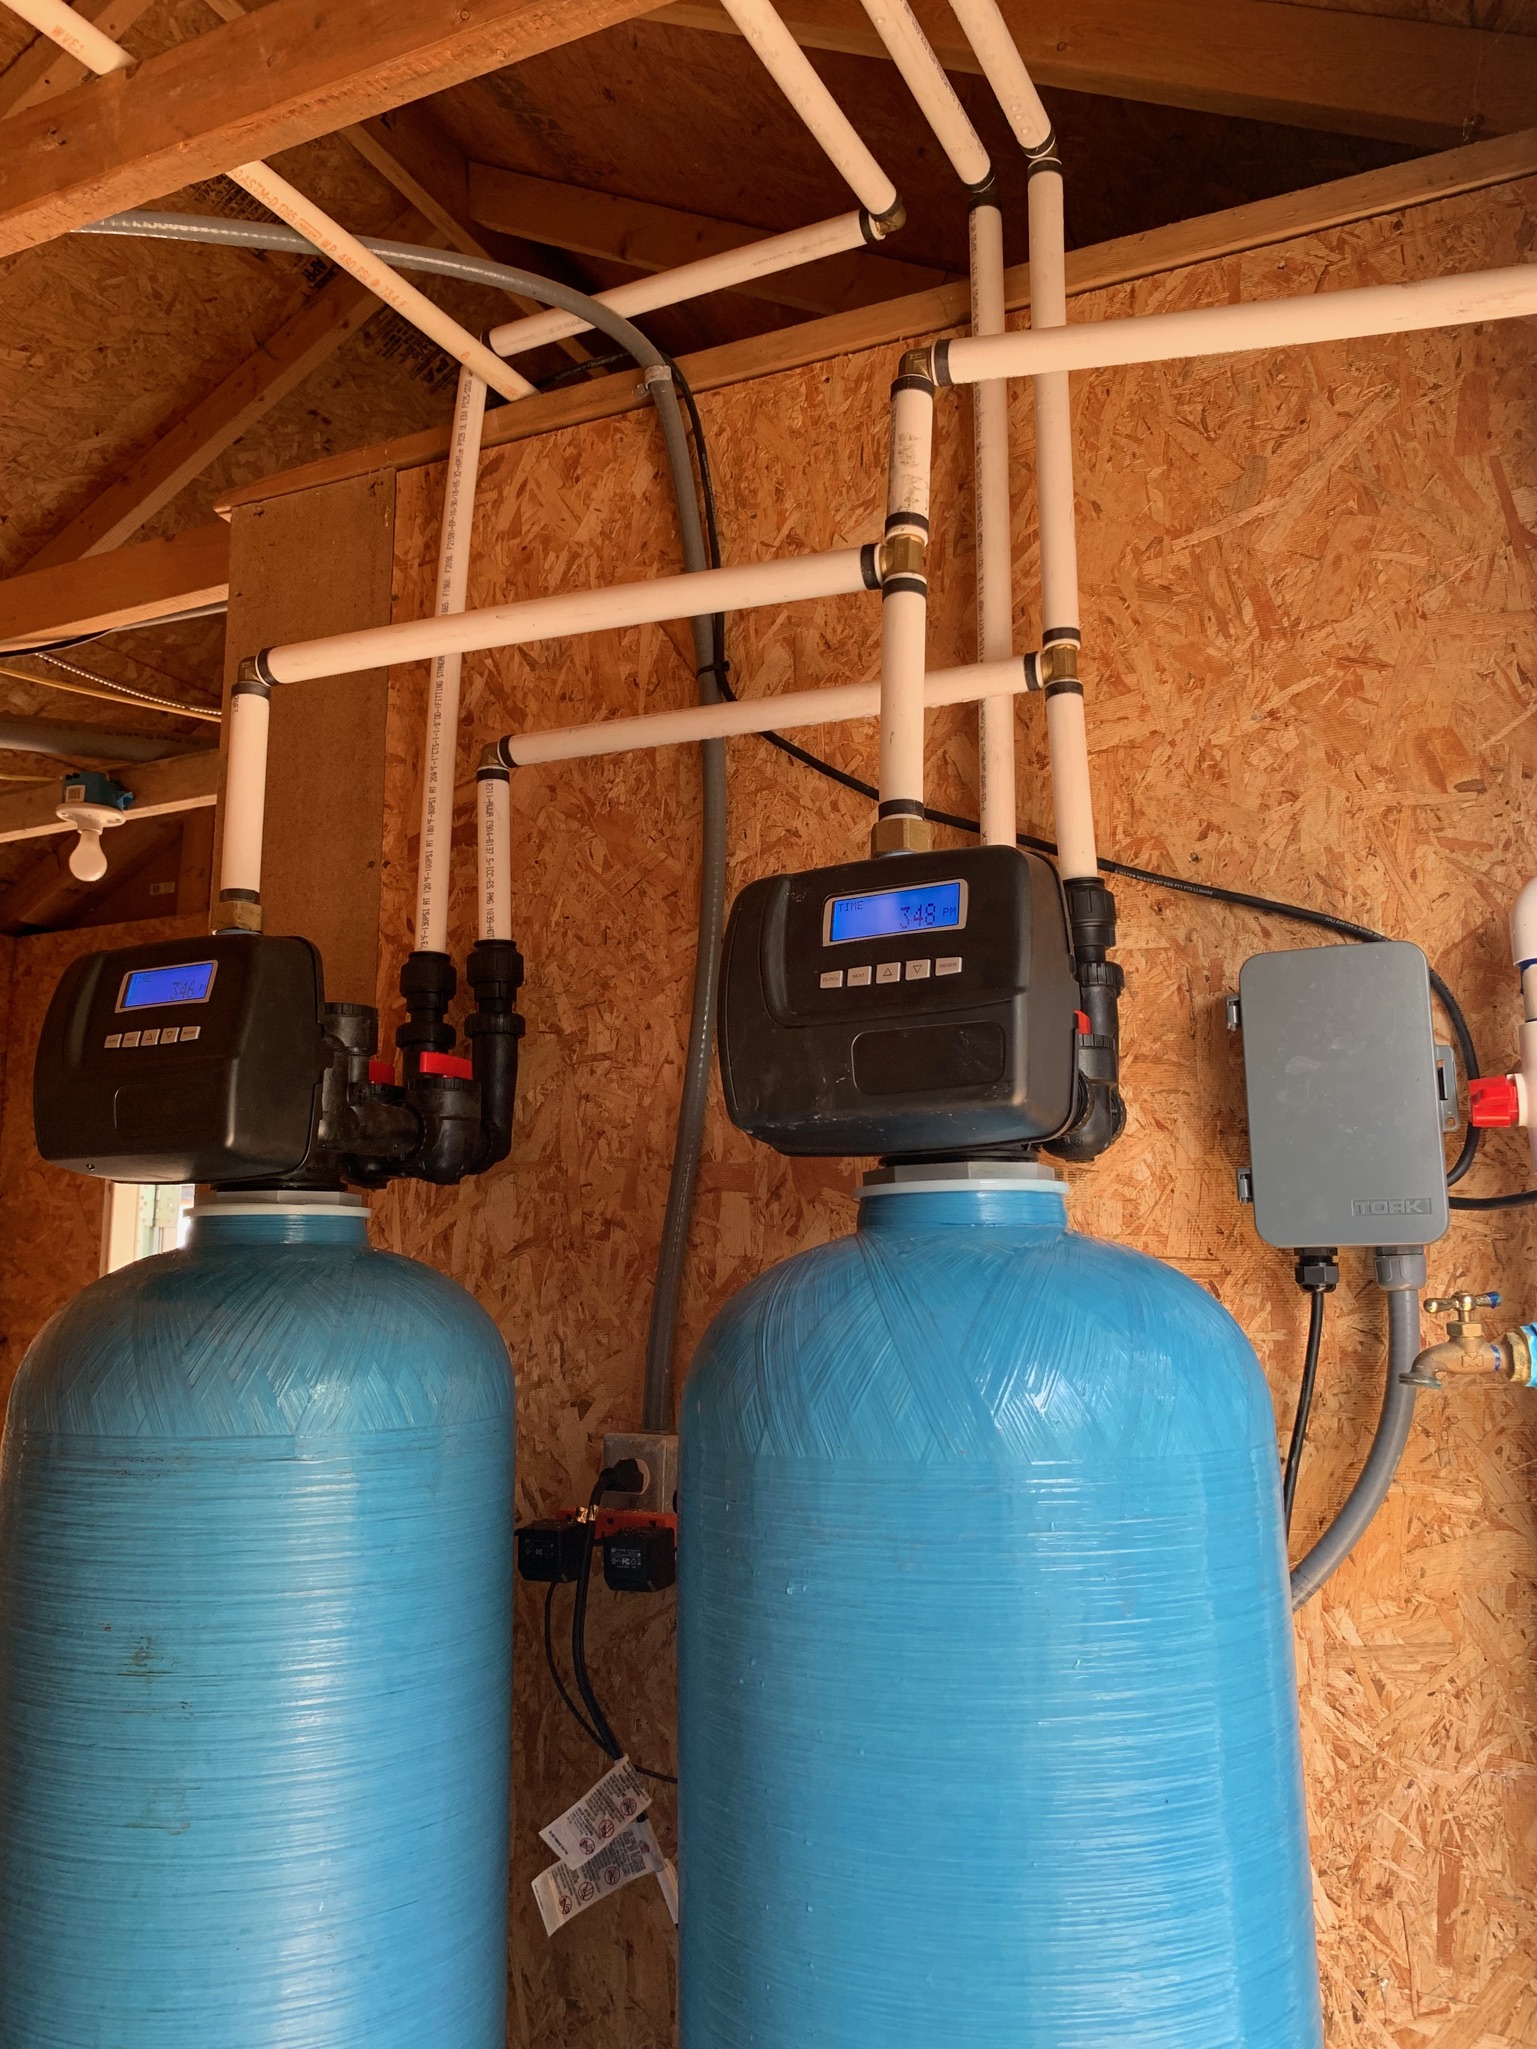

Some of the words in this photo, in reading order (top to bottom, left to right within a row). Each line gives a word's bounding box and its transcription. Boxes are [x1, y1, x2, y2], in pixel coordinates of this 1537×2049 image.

[422, 897, 430, 905] AT
[426, 839, 434, 847] AT
[1136, 875, 1162, 884] RESISTANT
[485, 892, 494, 905] PMG
[838, 900, 864, 913] TIME
[942, 906, 957, 917] PM
[134, 974, 152, 984] TIME
[1354, 1199, 1423, 1214] TORK
